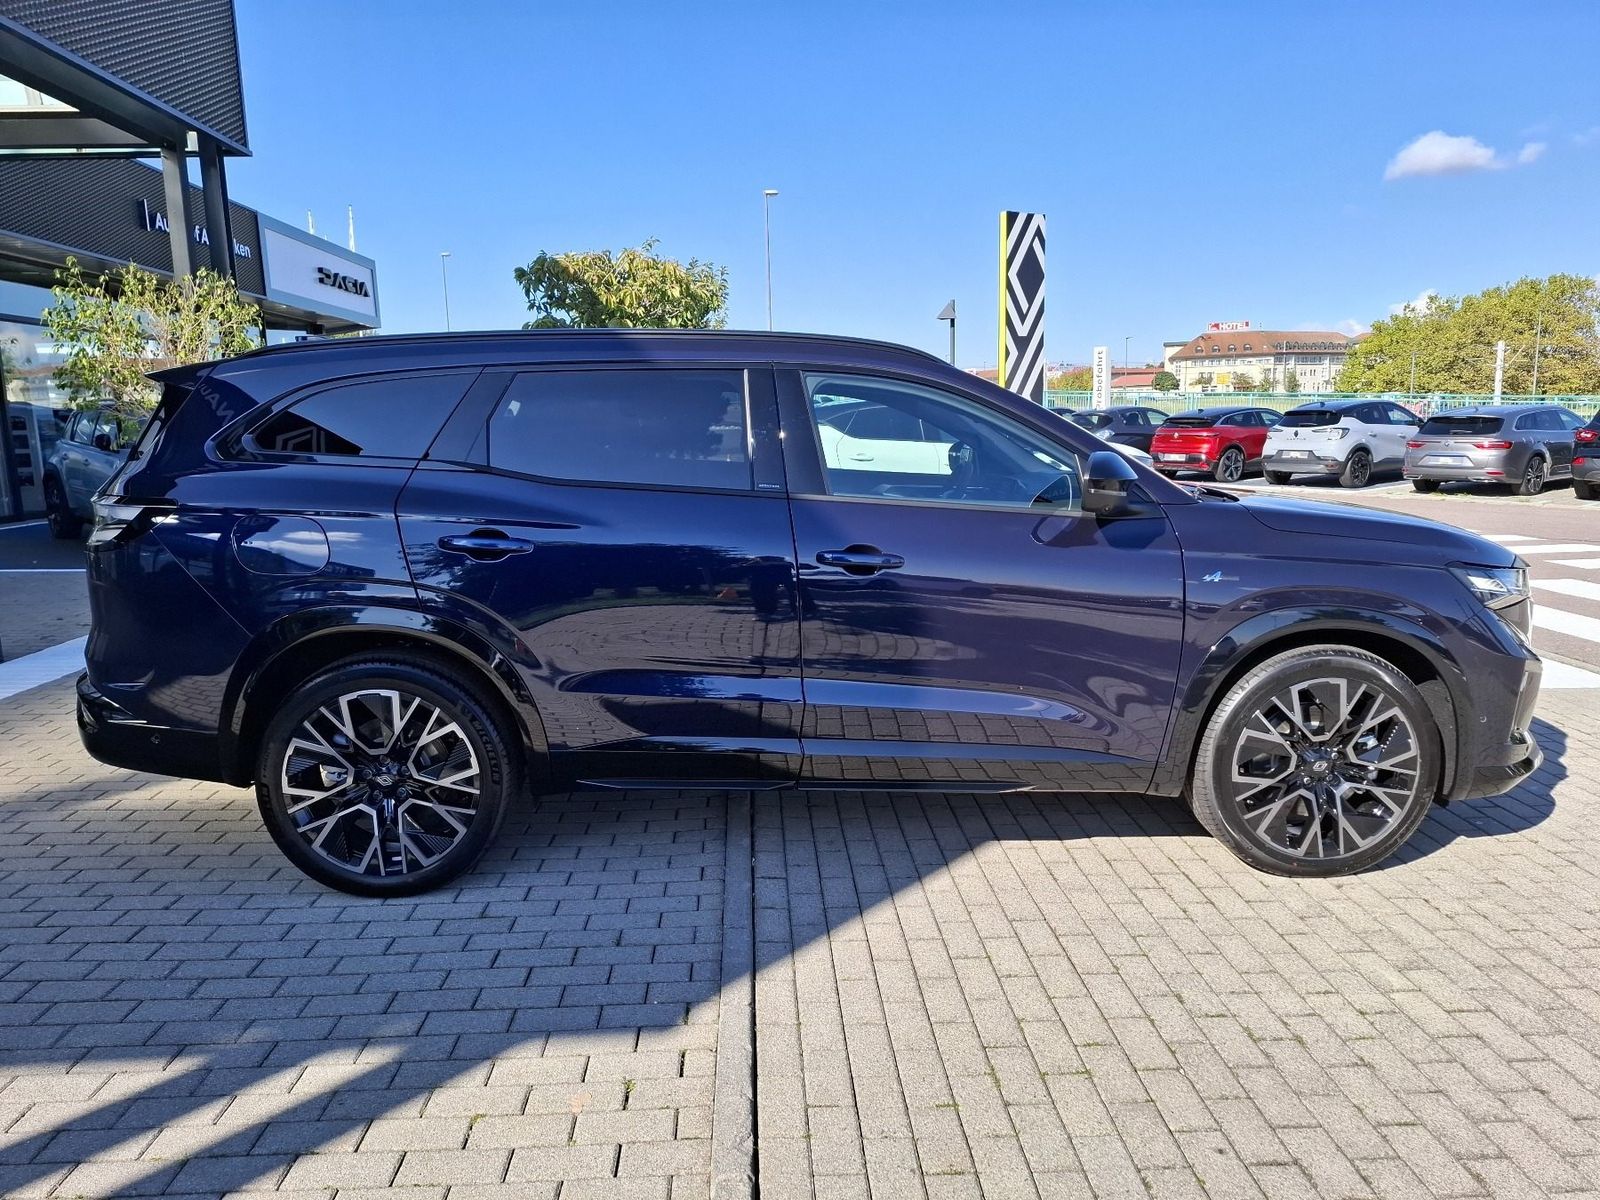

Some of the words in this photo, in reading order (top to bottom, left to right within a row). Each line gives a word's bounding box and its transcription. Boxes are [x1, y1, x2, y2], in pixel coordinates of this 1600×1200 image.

[317, 267, 371, 297] DACIA
[1219, 321, 1250, 331] HOTEL
[470, 718, 501, 785] MICHELIN
